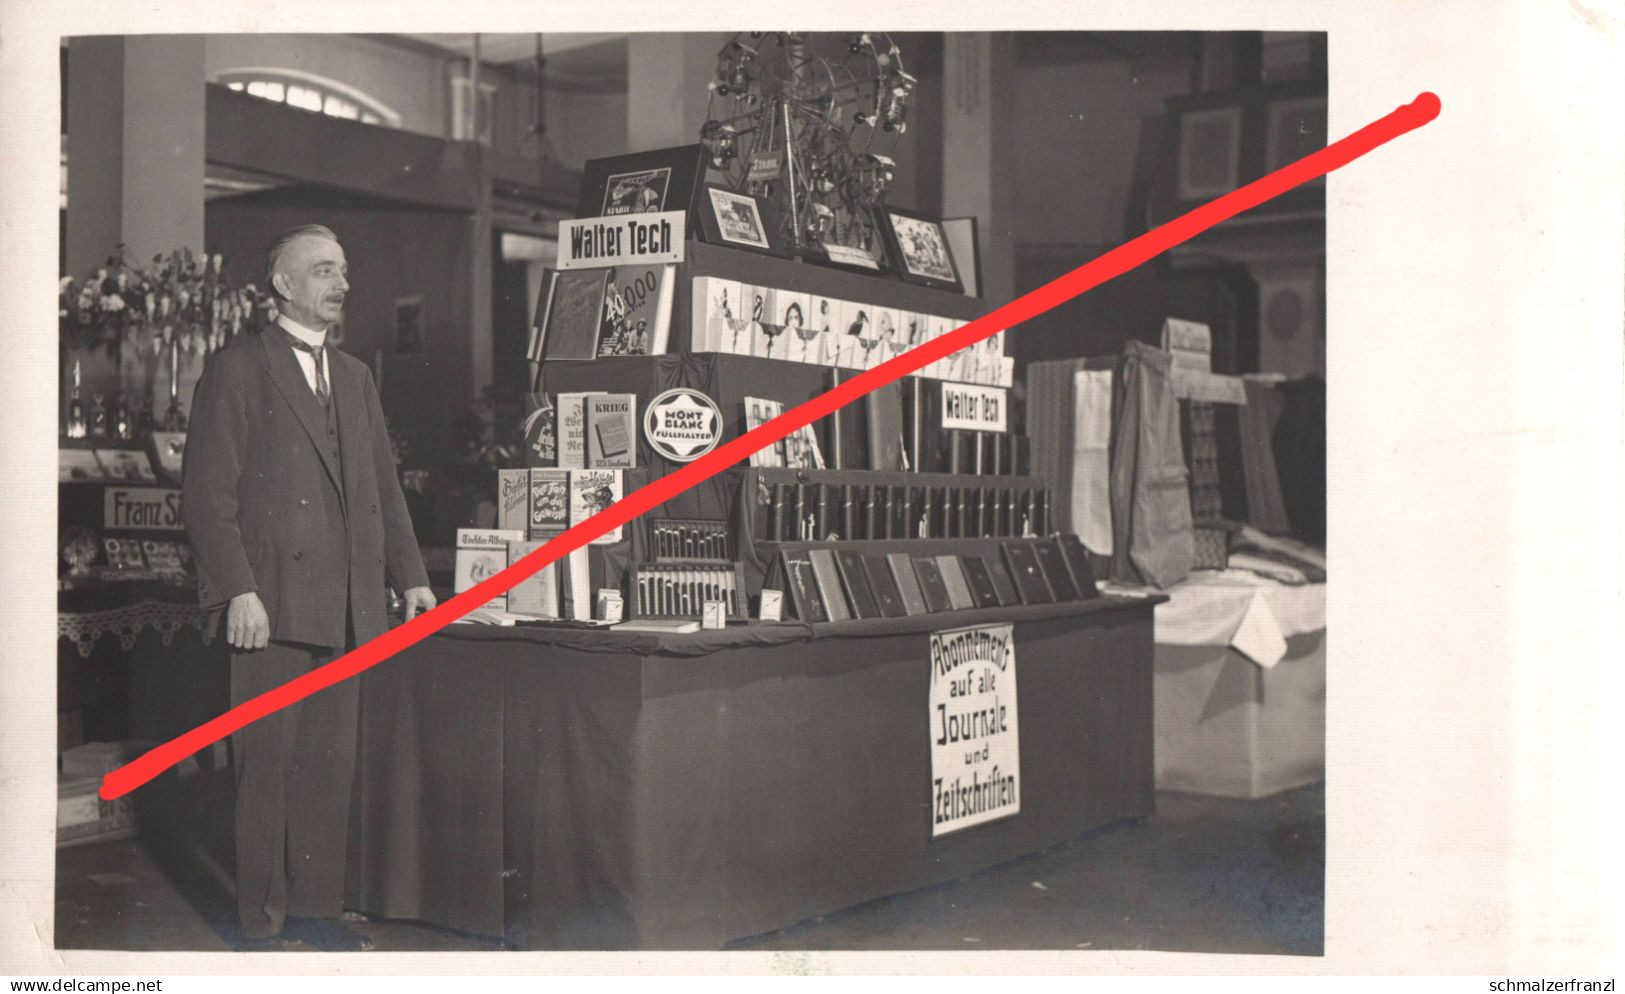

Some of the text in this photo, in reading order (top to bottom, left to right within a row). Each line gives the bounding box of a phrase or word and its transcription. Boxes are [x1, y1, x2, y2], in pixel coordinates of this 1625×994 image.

[571, 219, 672, 260] Walter Tech
[595, 403, 629, 413] KRIEG
[665, 410, 703, 420] MONT
[945, 390, 999, 422] Walter Tech
[665, 419, 703, 430] BLANC
[115, 492, 161, 526] Franz
[932, 629, 1009, 685] Abonnements
[978, 667, 996, 694] alle
[936, 695, 1008, 746] Journale
[964, 742, 989, 765] und
[934, 765, 1016, 824] Zeitschriften
